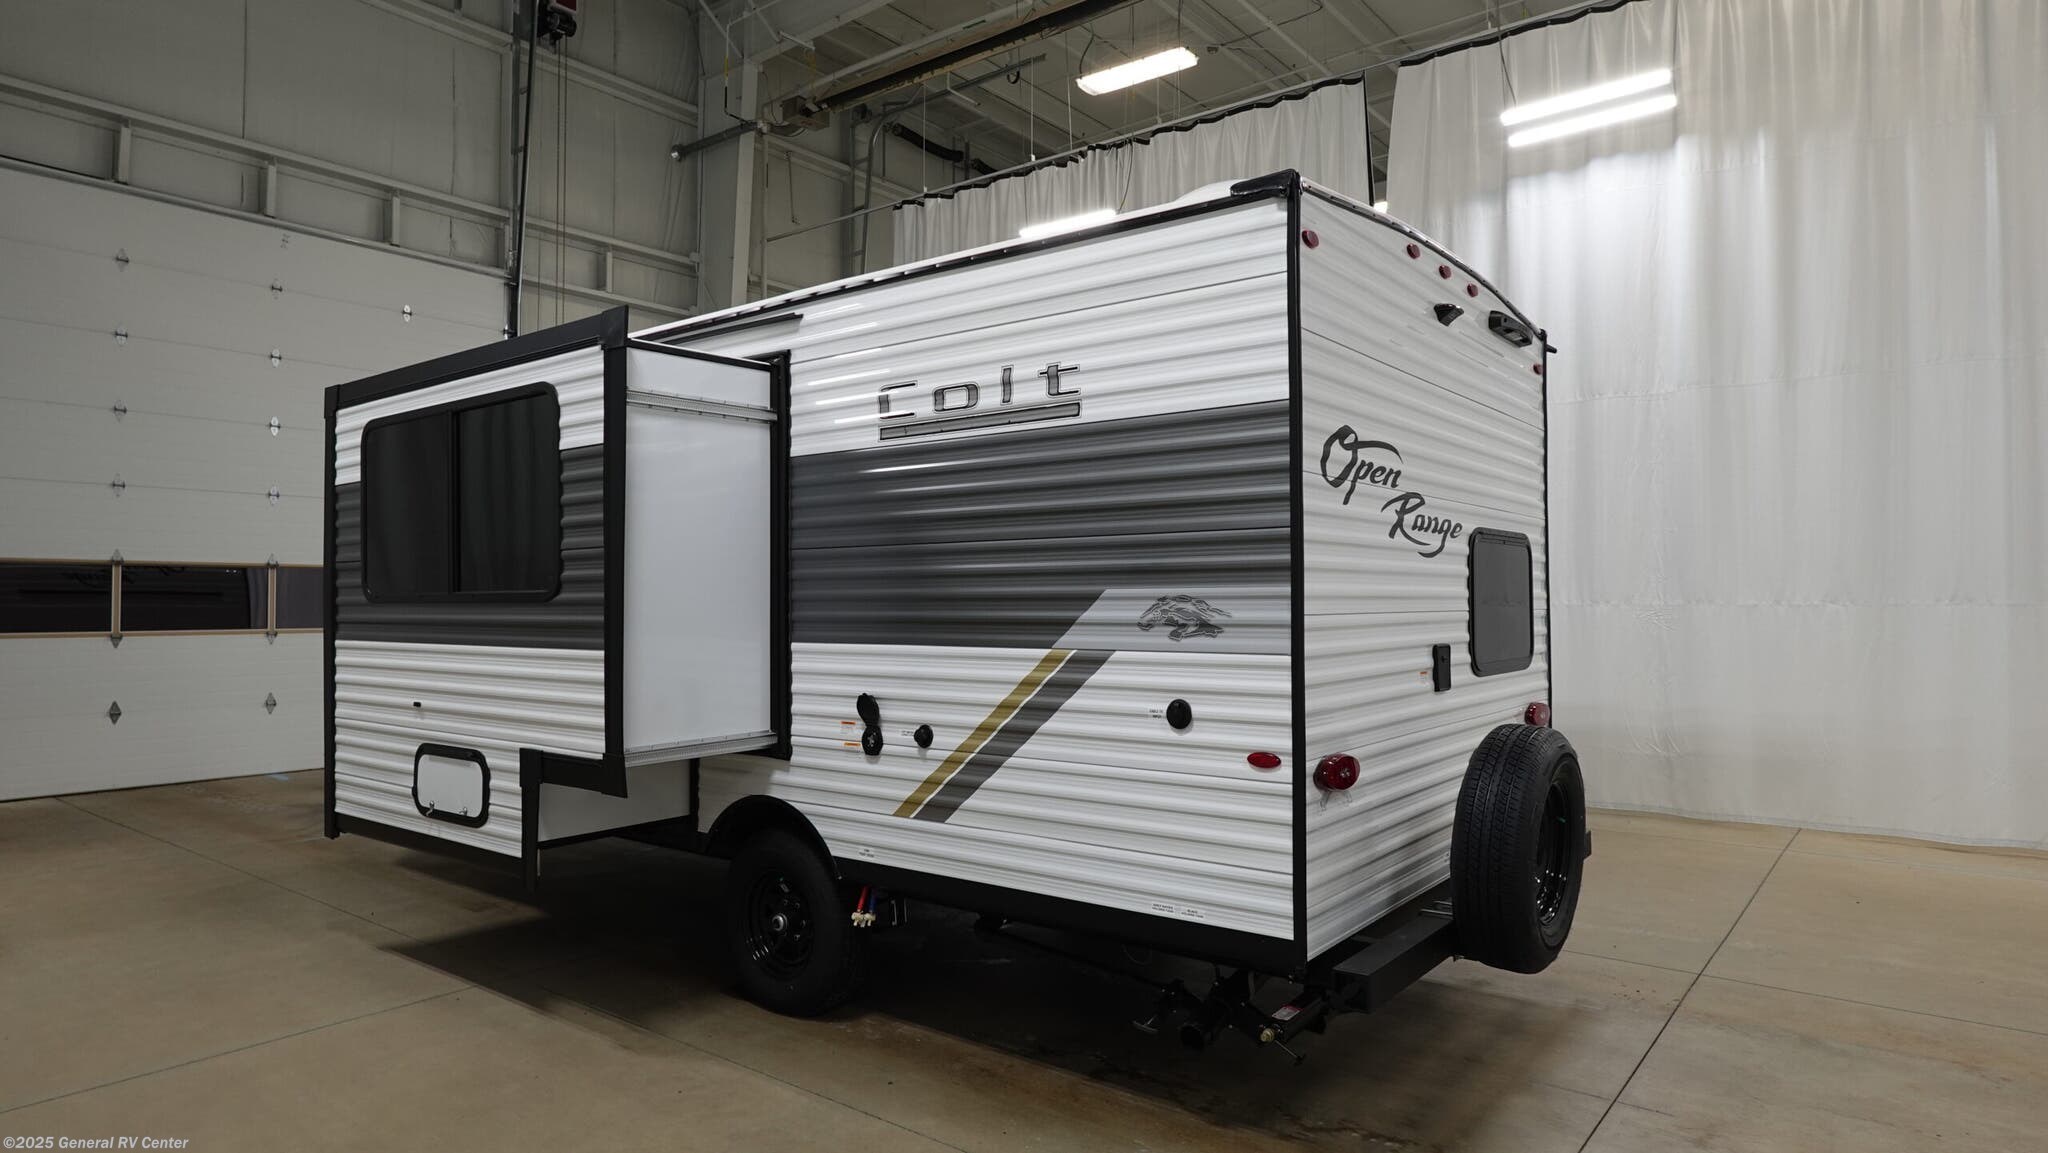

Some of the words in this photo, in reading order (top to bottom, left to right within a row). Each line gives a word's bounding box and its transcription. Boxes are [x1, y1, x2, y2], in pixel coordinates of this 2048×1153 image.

[877, 361, 1081, 420] Colt
[1320, 424, 1403, 505] Open
[1380, 491, 1463, 558] Range
